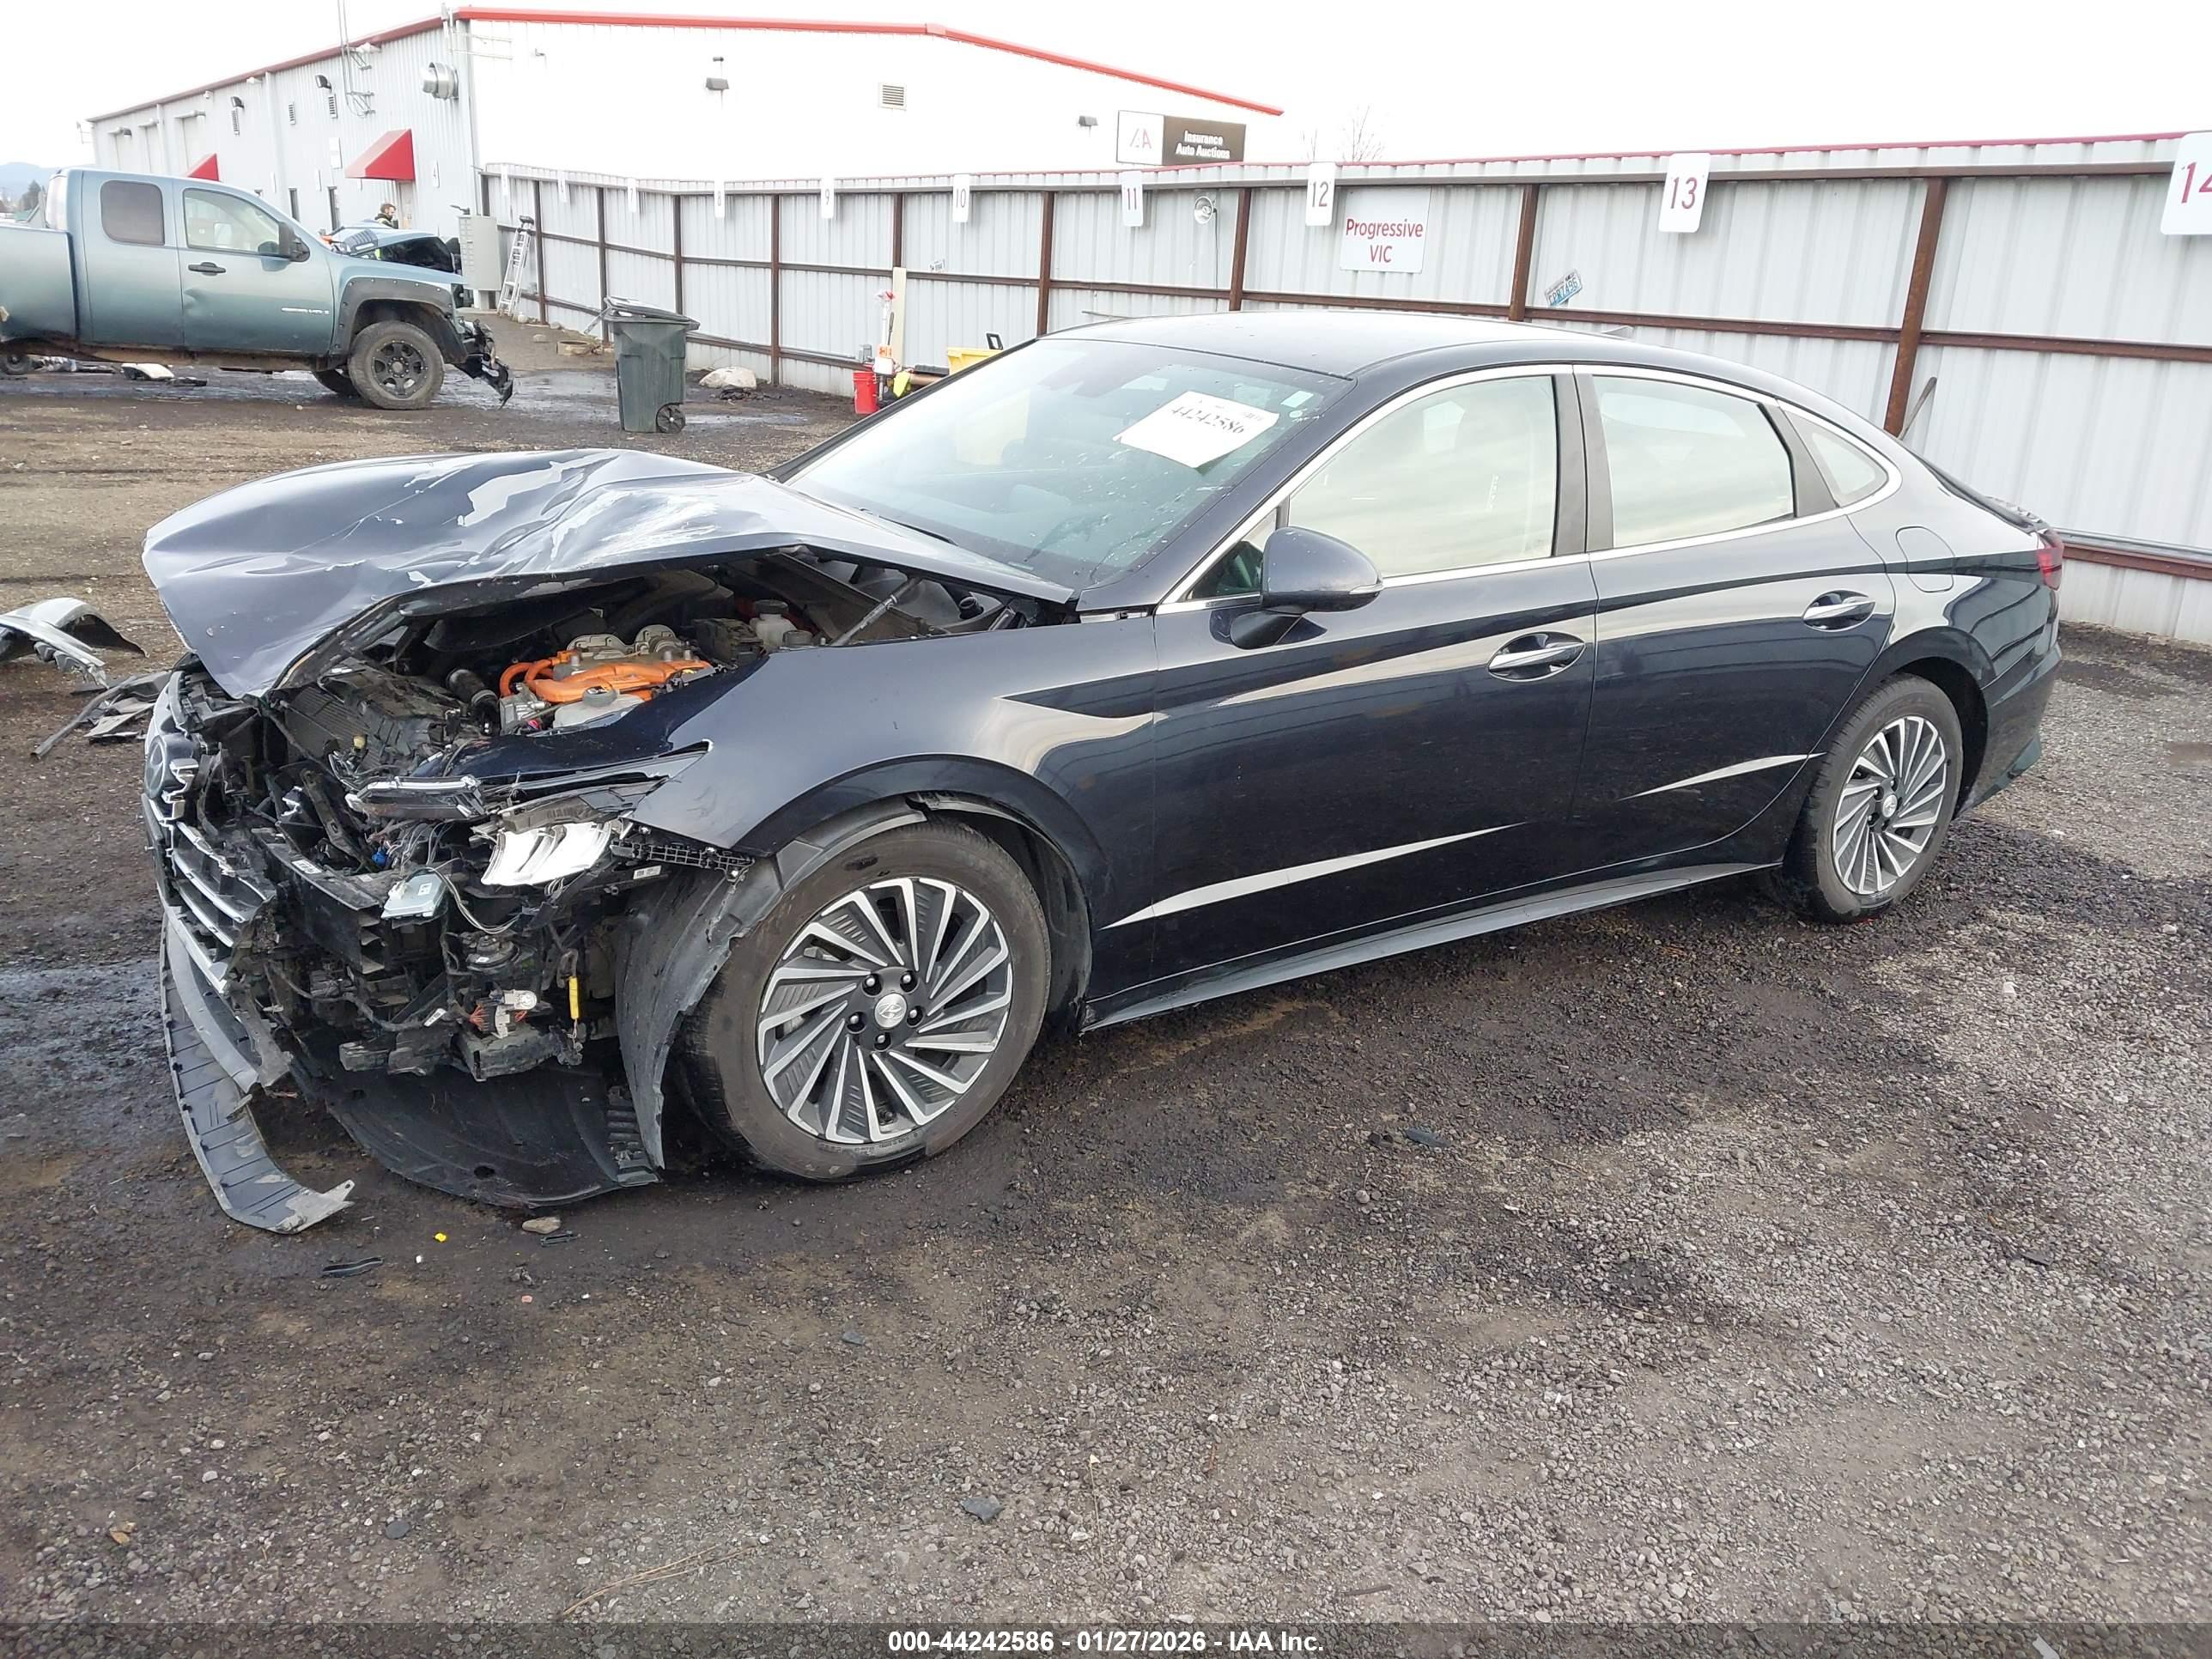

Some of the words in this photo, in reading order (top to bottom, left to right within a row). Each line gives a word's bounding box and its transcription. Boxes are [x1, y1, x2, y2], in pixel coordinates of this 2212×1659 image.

[1184, 130, 1224, 145] Insurance
[1175, 143, 1195, 155] Auto
[1195, 144, 1231, 159] Auctions
[716, 191, 722, 207] 8
[824, 188, 830, 206] 9
[955, 188, 967, 209] 10
[1127, 186, 1138, 211] 11
[1311, 180, 1329, 208] 12
[1670, 176, 1698, 210] 13
[1346, 218, 1423, 240] Progressive
[1369, 244, 1393, 263] VIC
